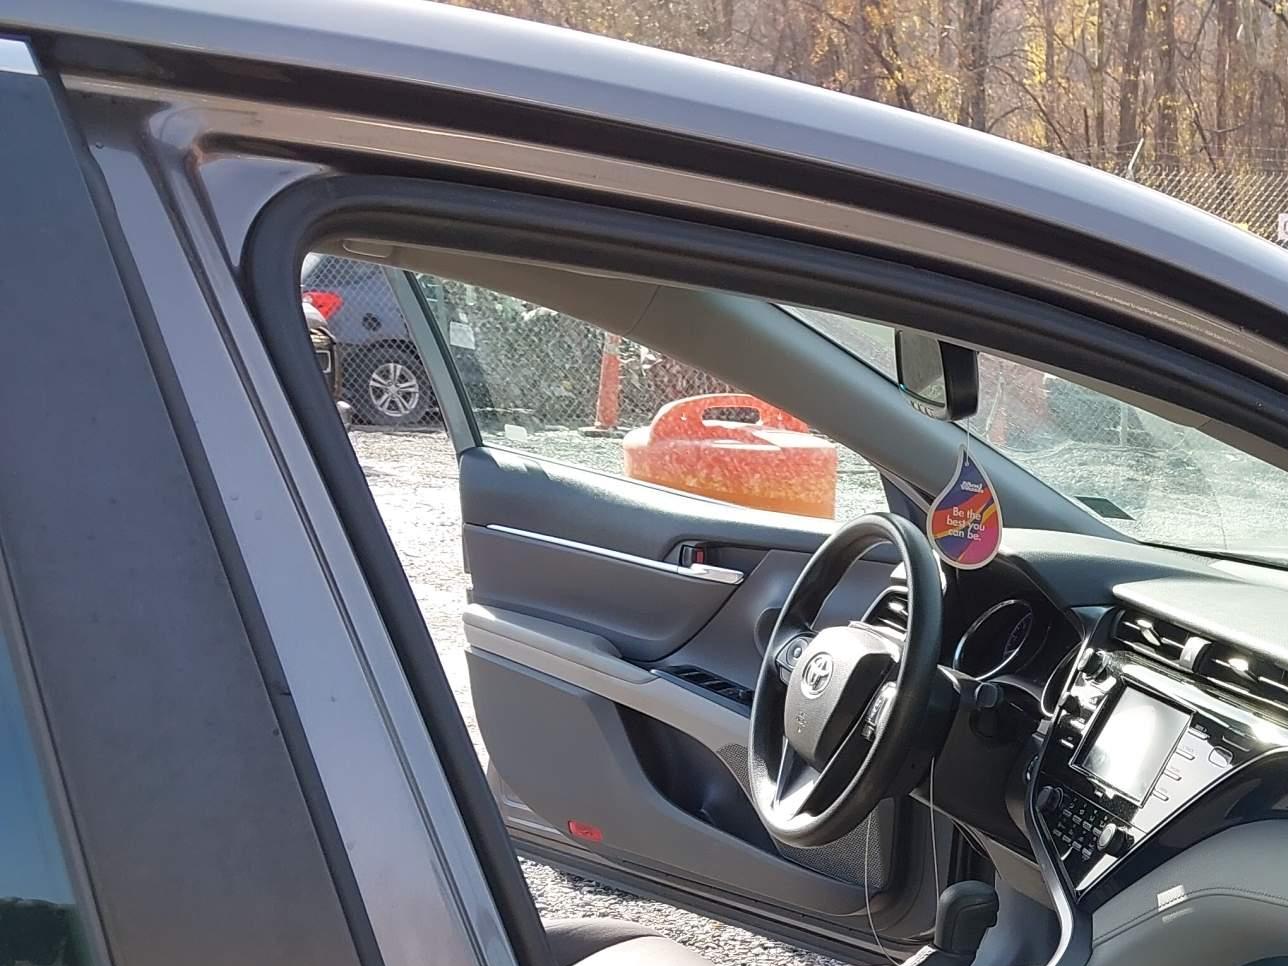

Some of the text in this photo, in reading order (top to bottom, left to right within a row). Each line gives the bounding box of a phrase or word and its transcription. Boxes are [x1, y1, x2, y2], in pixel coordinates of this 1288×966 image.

[953, 507, 981, 520] Be the
[947, 514, 985, 533] best you
[949, 529, 965, 538] can
